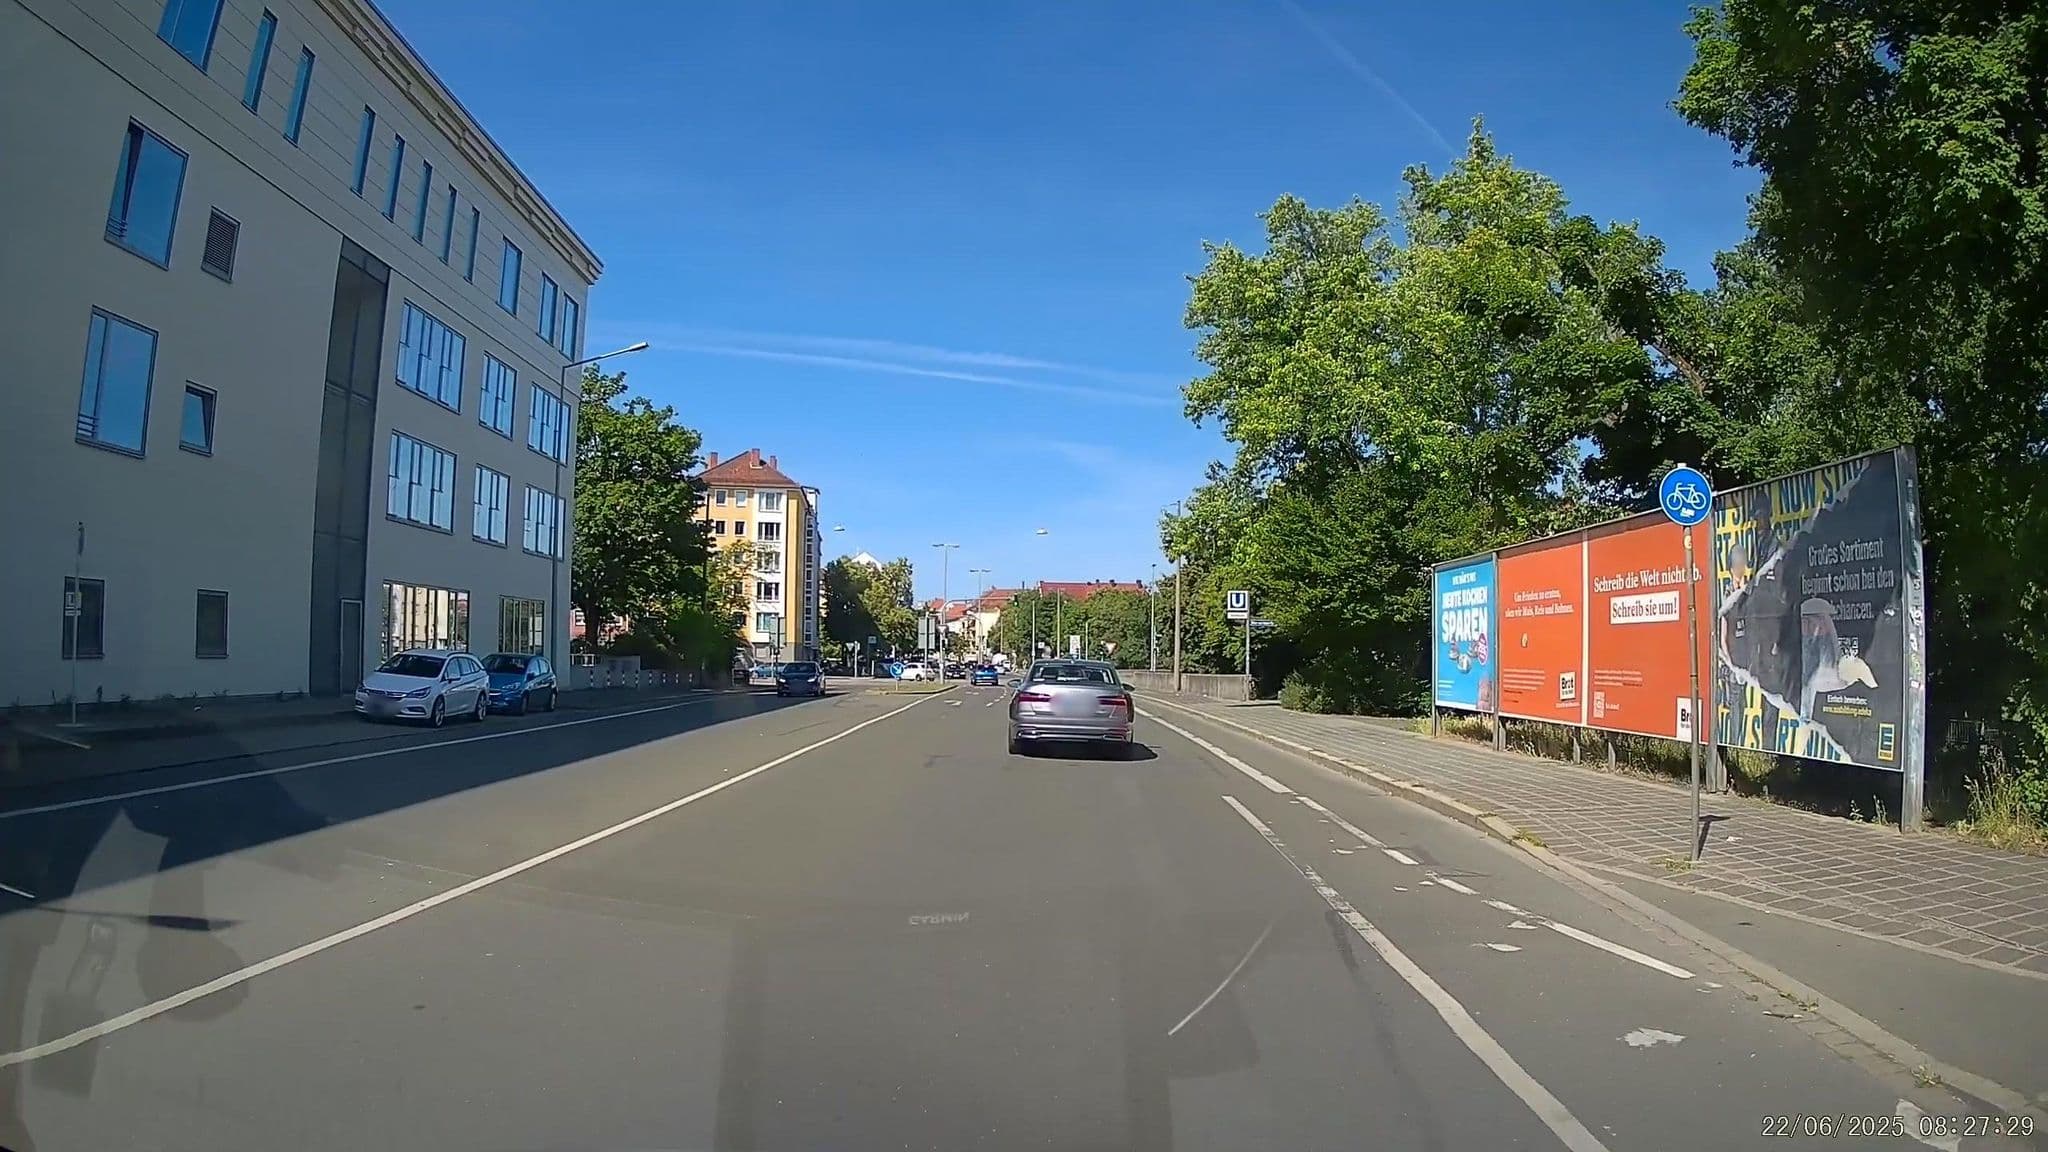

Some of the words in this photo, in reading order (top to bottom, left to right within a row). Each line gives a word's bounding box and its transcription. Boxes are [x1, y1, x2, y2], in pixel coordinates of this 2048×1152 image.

[1808, 543, 1838, 567] Großes
[1839, 537, 1884, 564] Sortiment
[1594, 574, 1624, 592] Schreib
[1625, 571, 1639, 588] die
[1640, 568, 1660, 586] Welt
[1661, 565, 1686, 584] nicht
[1802, 573, 1832, 597] beginnt
[1833, 569, 1860, 592] schon
[1861, 567, 1876, 590] bei
[1877, 565, 1894, 588] den
[1231, 593, 1244, 607] U
[1612, 600, 1644, 618] Schreib
[1645, 599, 1657, 616] sie
[1659, 597, 1677, 614] um!
[1442, 607, 1488, 643] SPAREN
